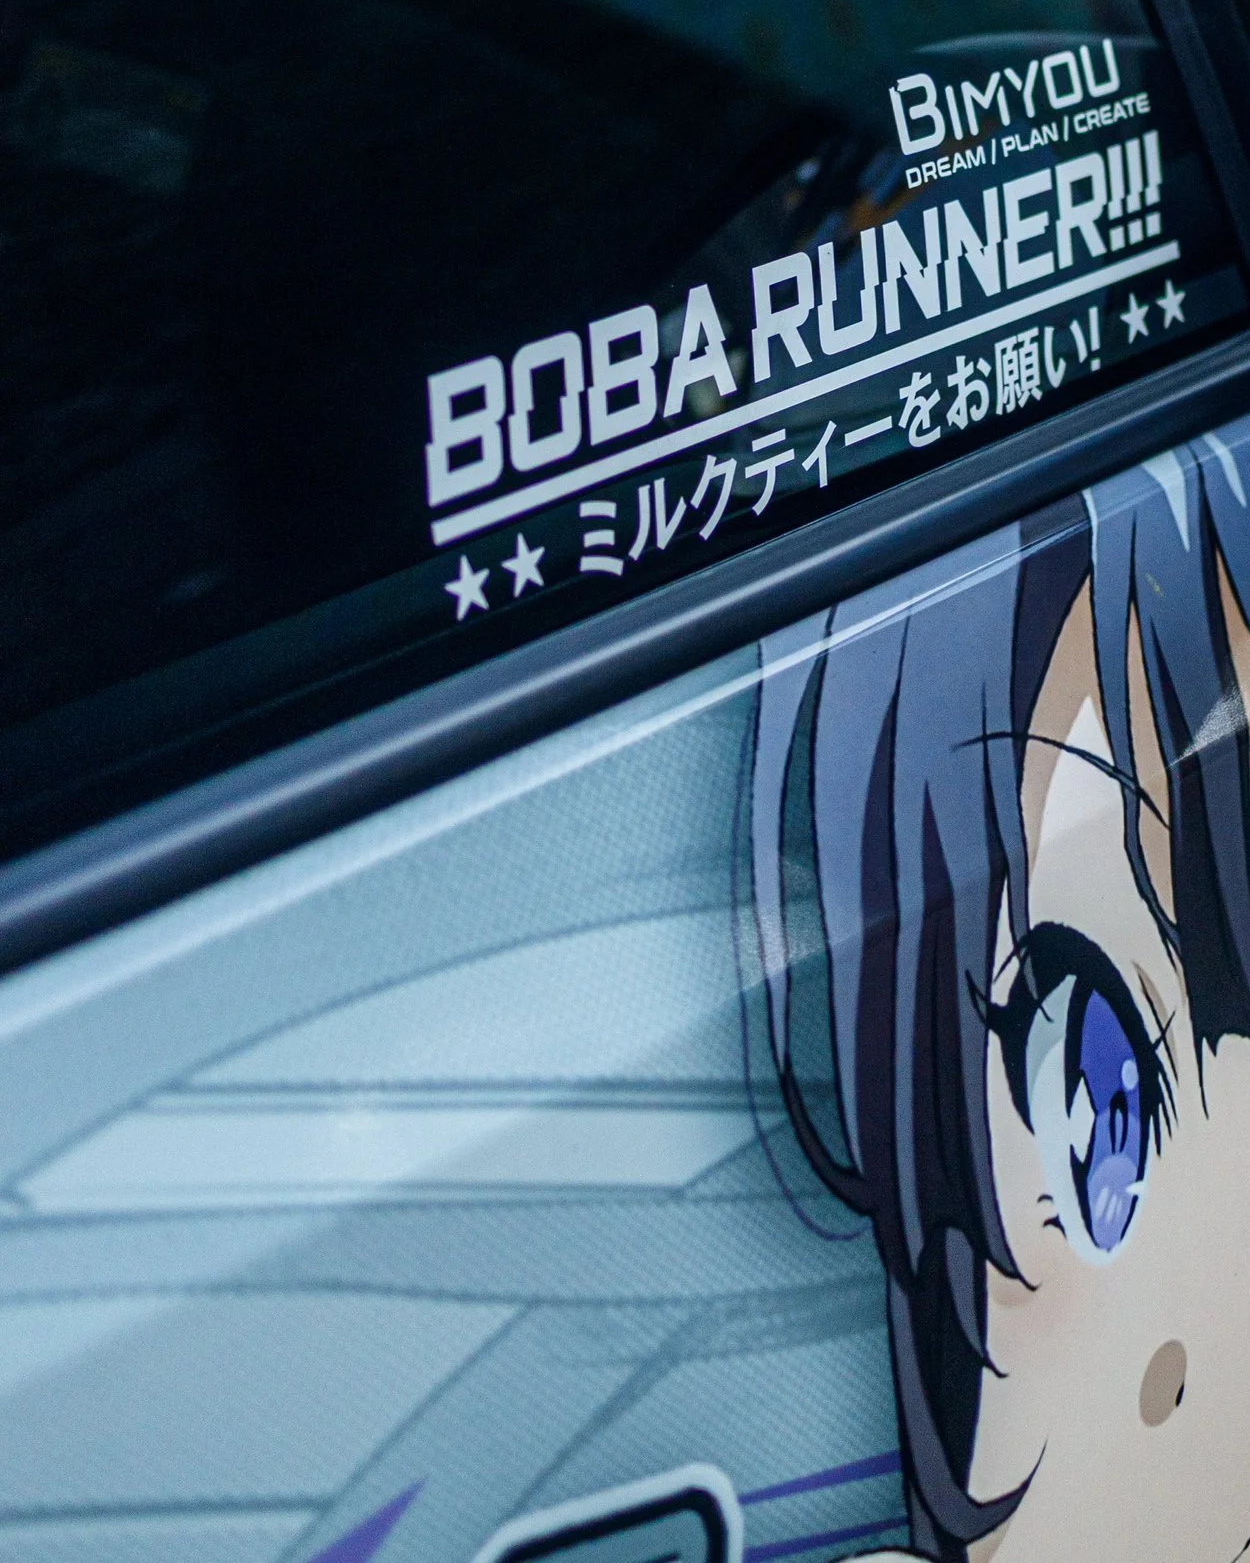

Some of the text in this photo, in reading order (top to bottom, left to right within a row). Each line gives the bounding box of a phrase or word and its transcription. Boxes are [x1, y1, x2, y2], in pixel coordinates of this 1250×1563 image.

[905, 144, 987, 189] DREAM
[1001, 122, 1059, 158] PLAN
[1073, 92, 1150, 134] CREATE
[426, 131, 1163, 507] BOBA RUNNER!!!
